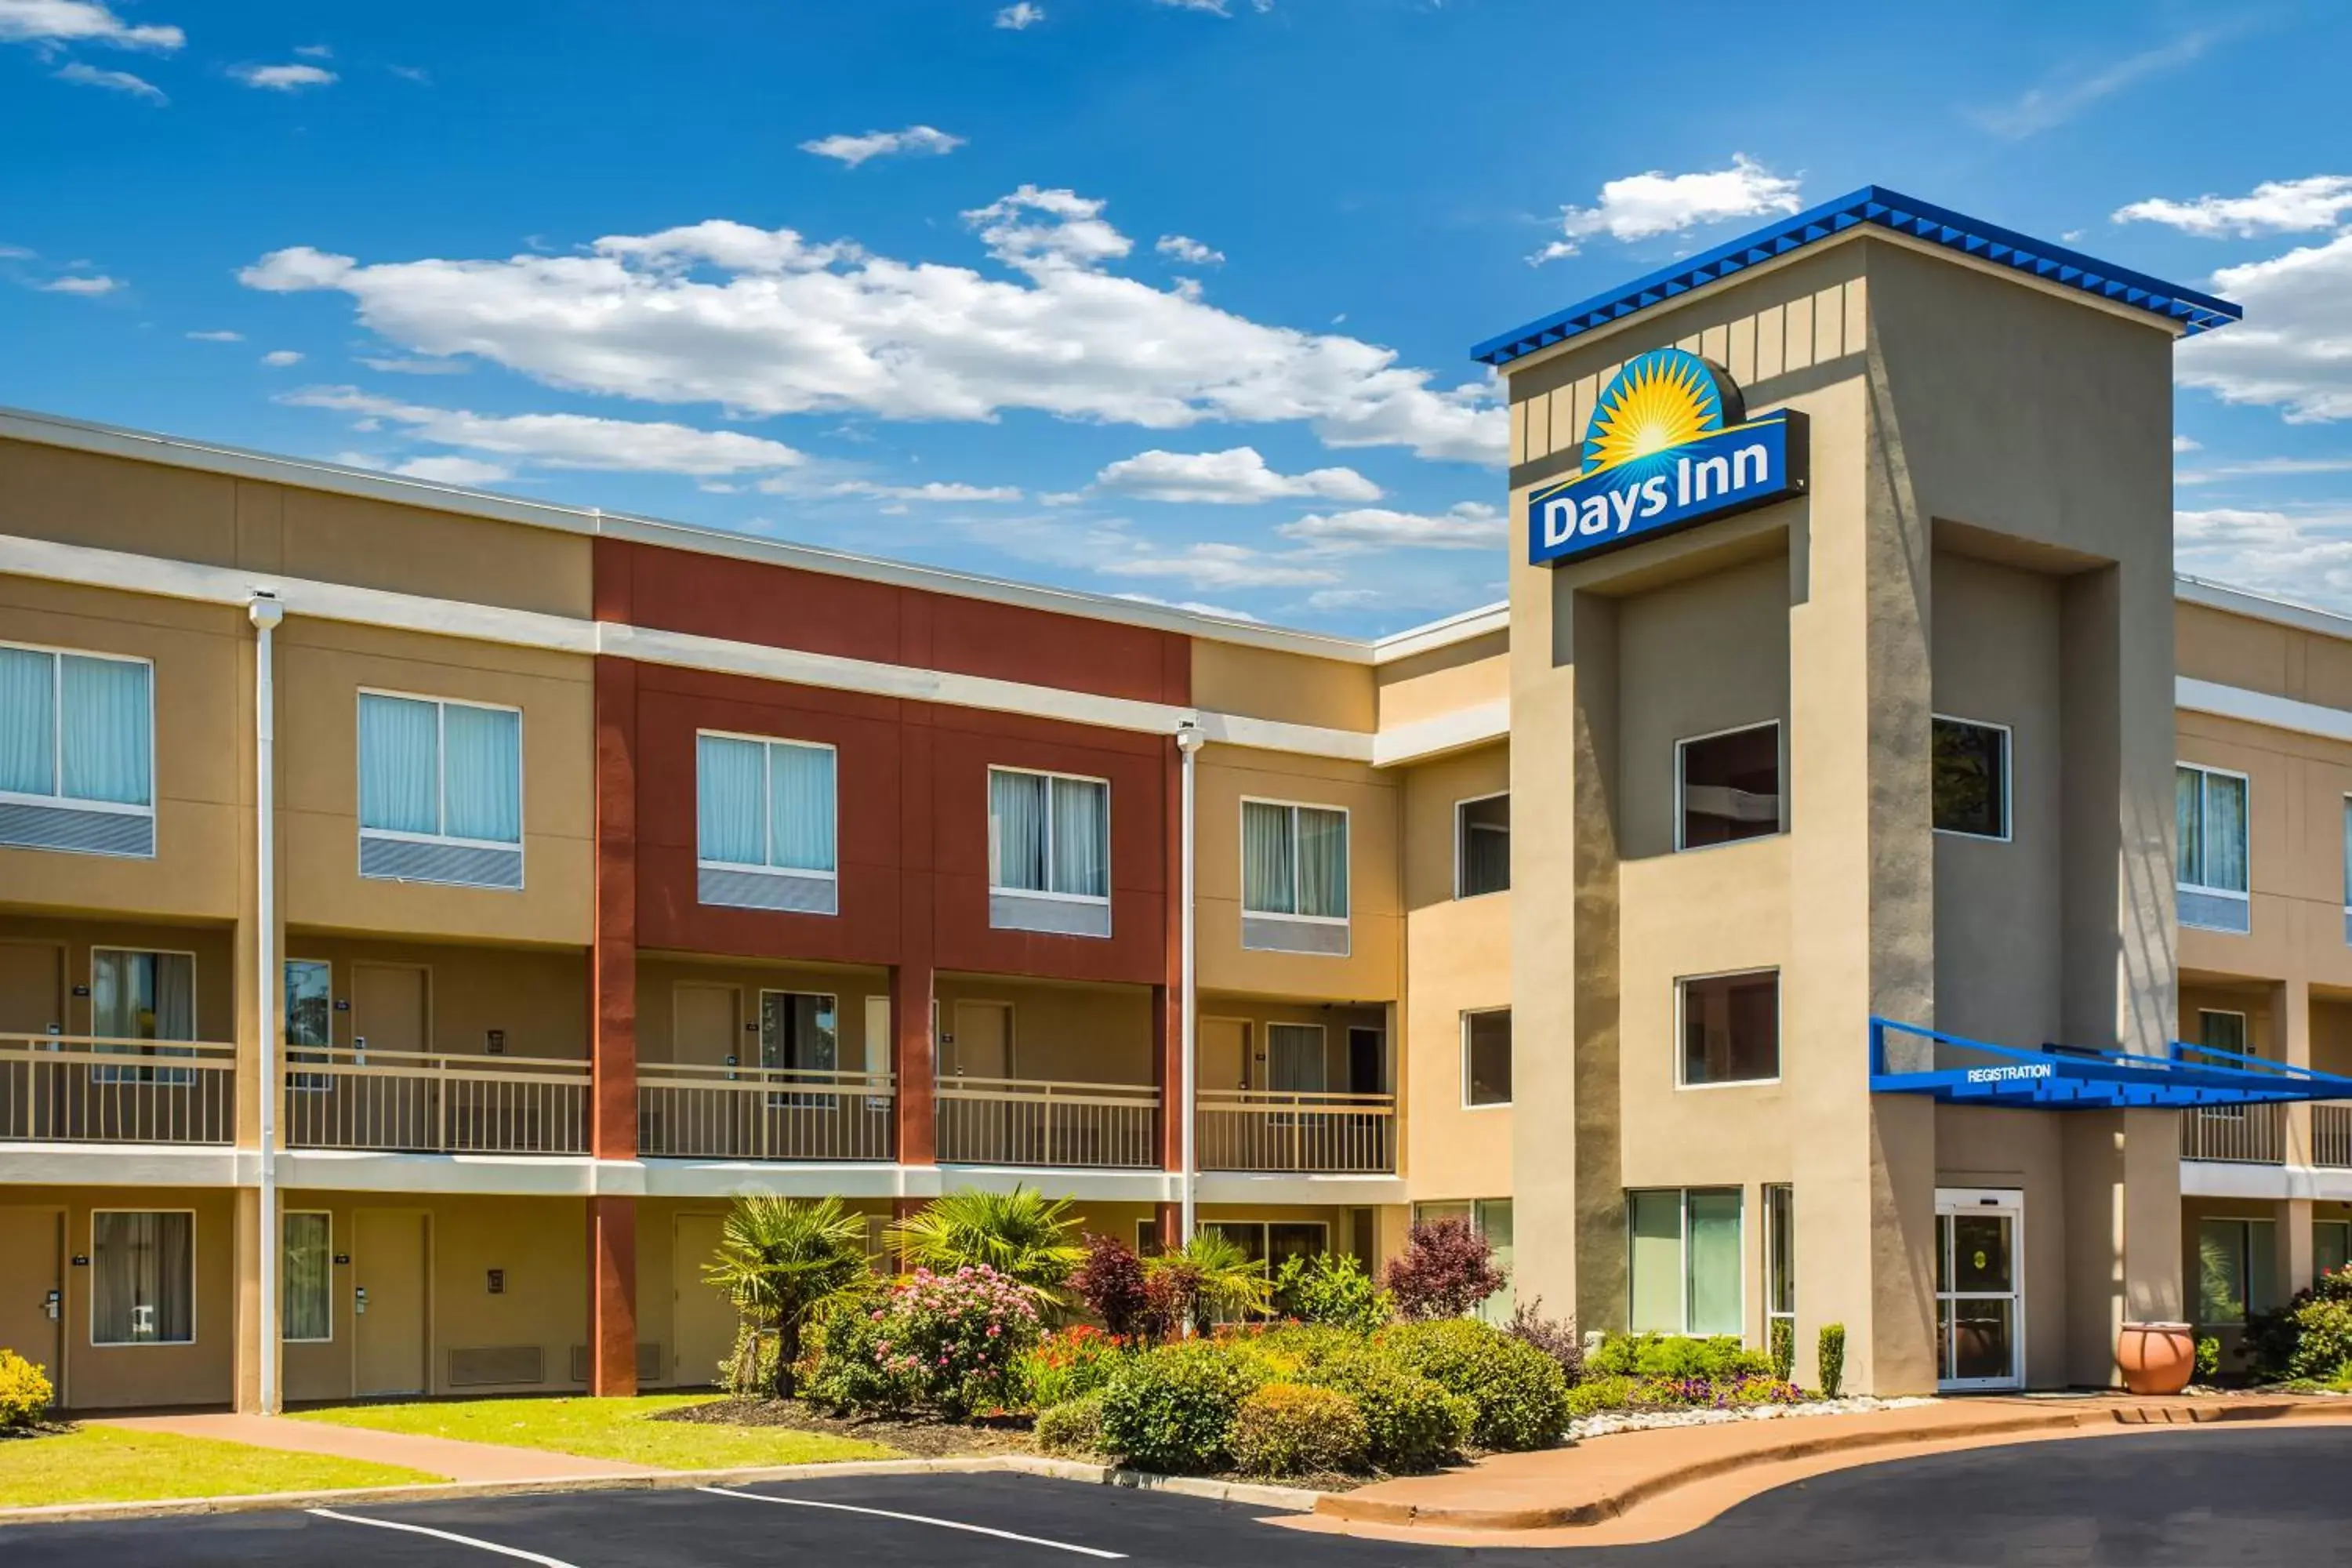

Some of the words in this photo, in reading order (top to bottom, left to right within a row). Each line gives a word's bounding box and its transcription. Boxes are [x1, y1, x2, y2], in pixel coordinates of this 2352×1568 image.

[1544, 475, 1668, 548] Days
[1677, 443, 1768, 508] Inn
[1967, 1063, 2051, 1083] REGISTRATION
